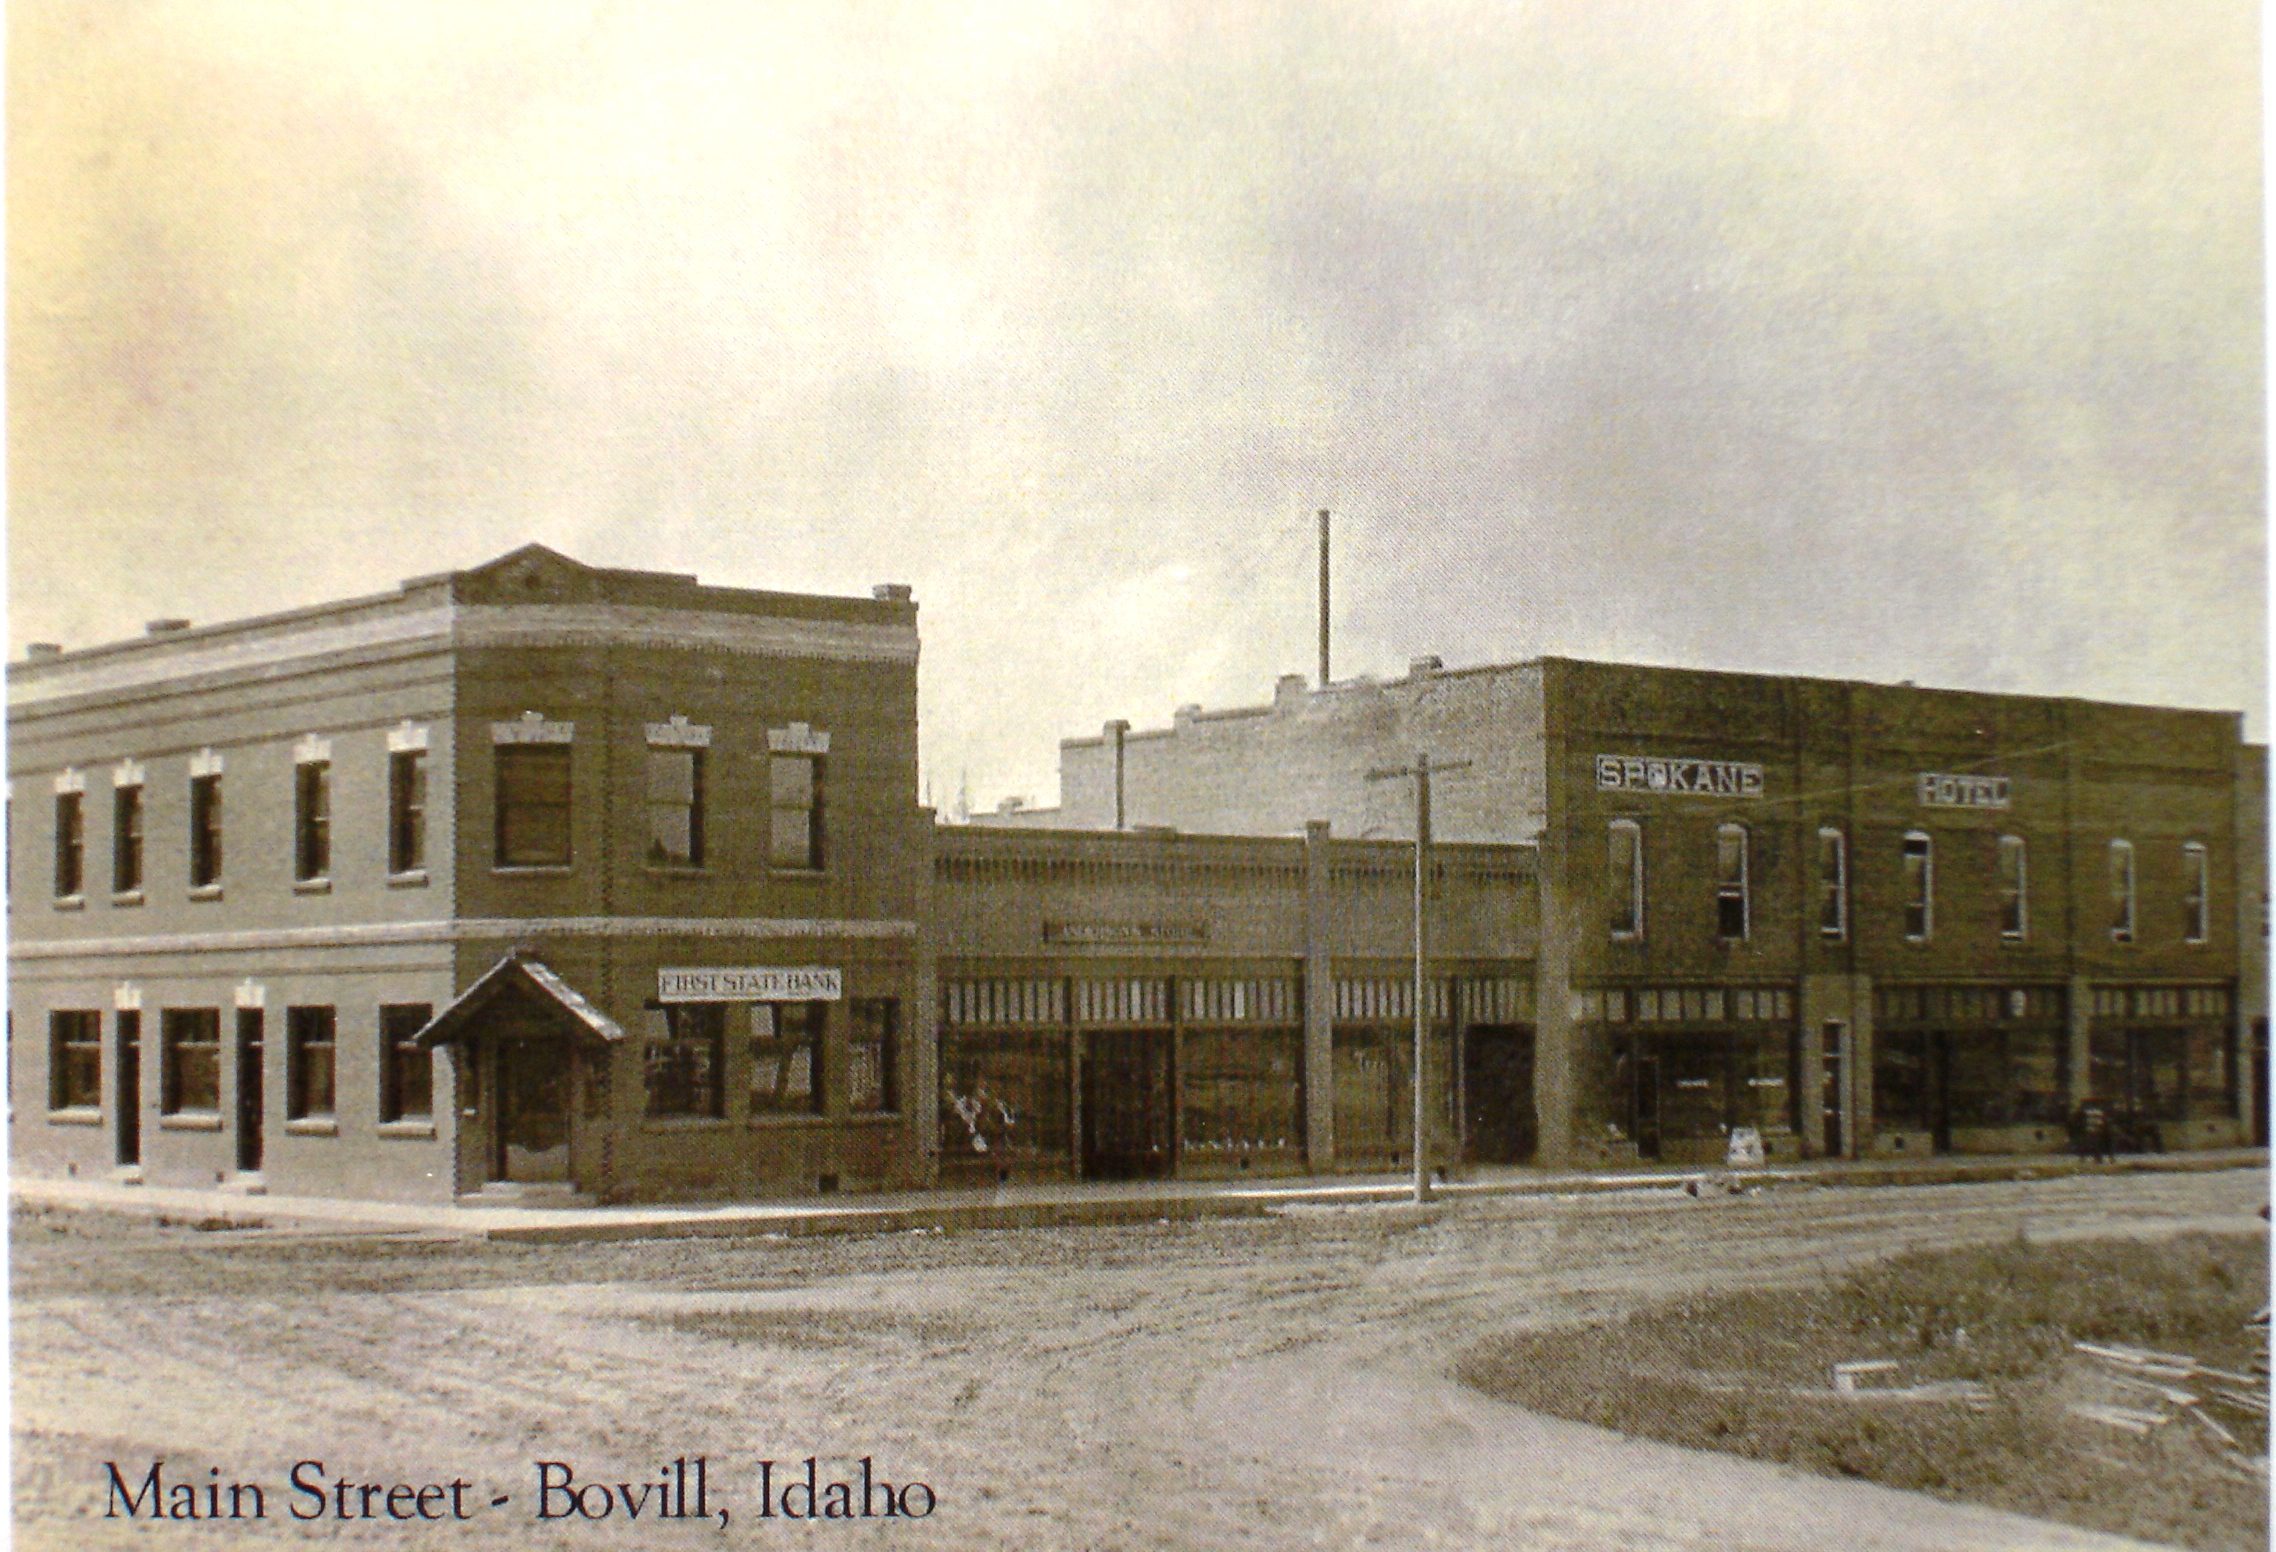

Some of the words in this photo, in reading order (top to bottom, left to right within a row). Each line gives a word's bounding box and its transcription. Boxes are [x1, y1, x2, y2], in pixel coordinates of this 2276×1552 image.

[1599, 756, 1763, 797] SPOKANE
[1919, 773, 2010, 807] HOTEL
[660, 973, 718, 993] FIRST
[722, 973, 783, 993] STATE
[786, 972, 839, 992] BANK
